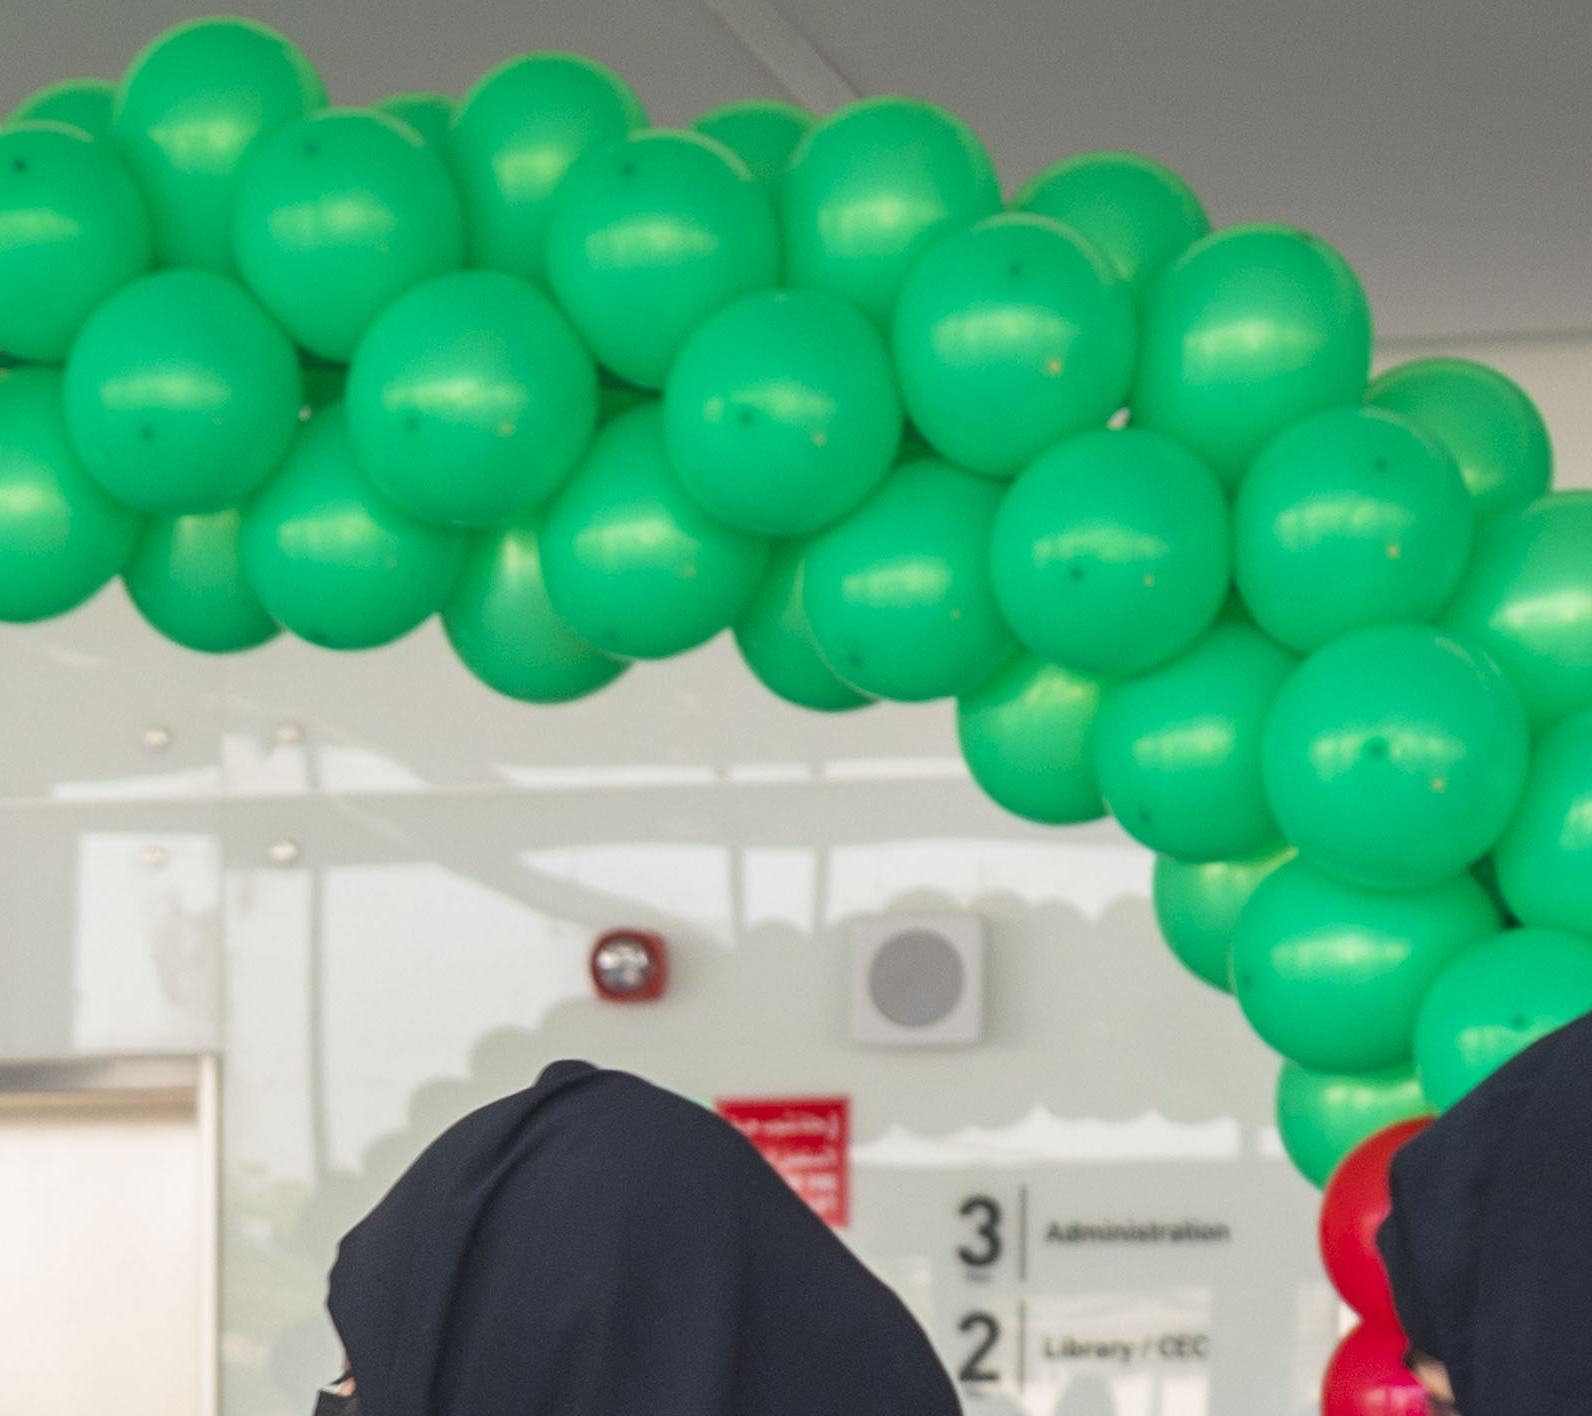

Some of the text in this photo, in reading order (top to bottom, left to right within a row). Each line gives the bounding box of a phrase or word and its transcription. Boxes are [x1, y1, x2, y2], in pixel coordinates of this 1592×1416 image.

[956, 1194, 1231, 1268] 3 Administration
[957, 1310, 1001, 1381] 2
[1043, 1334, 1133, 1366] Library
